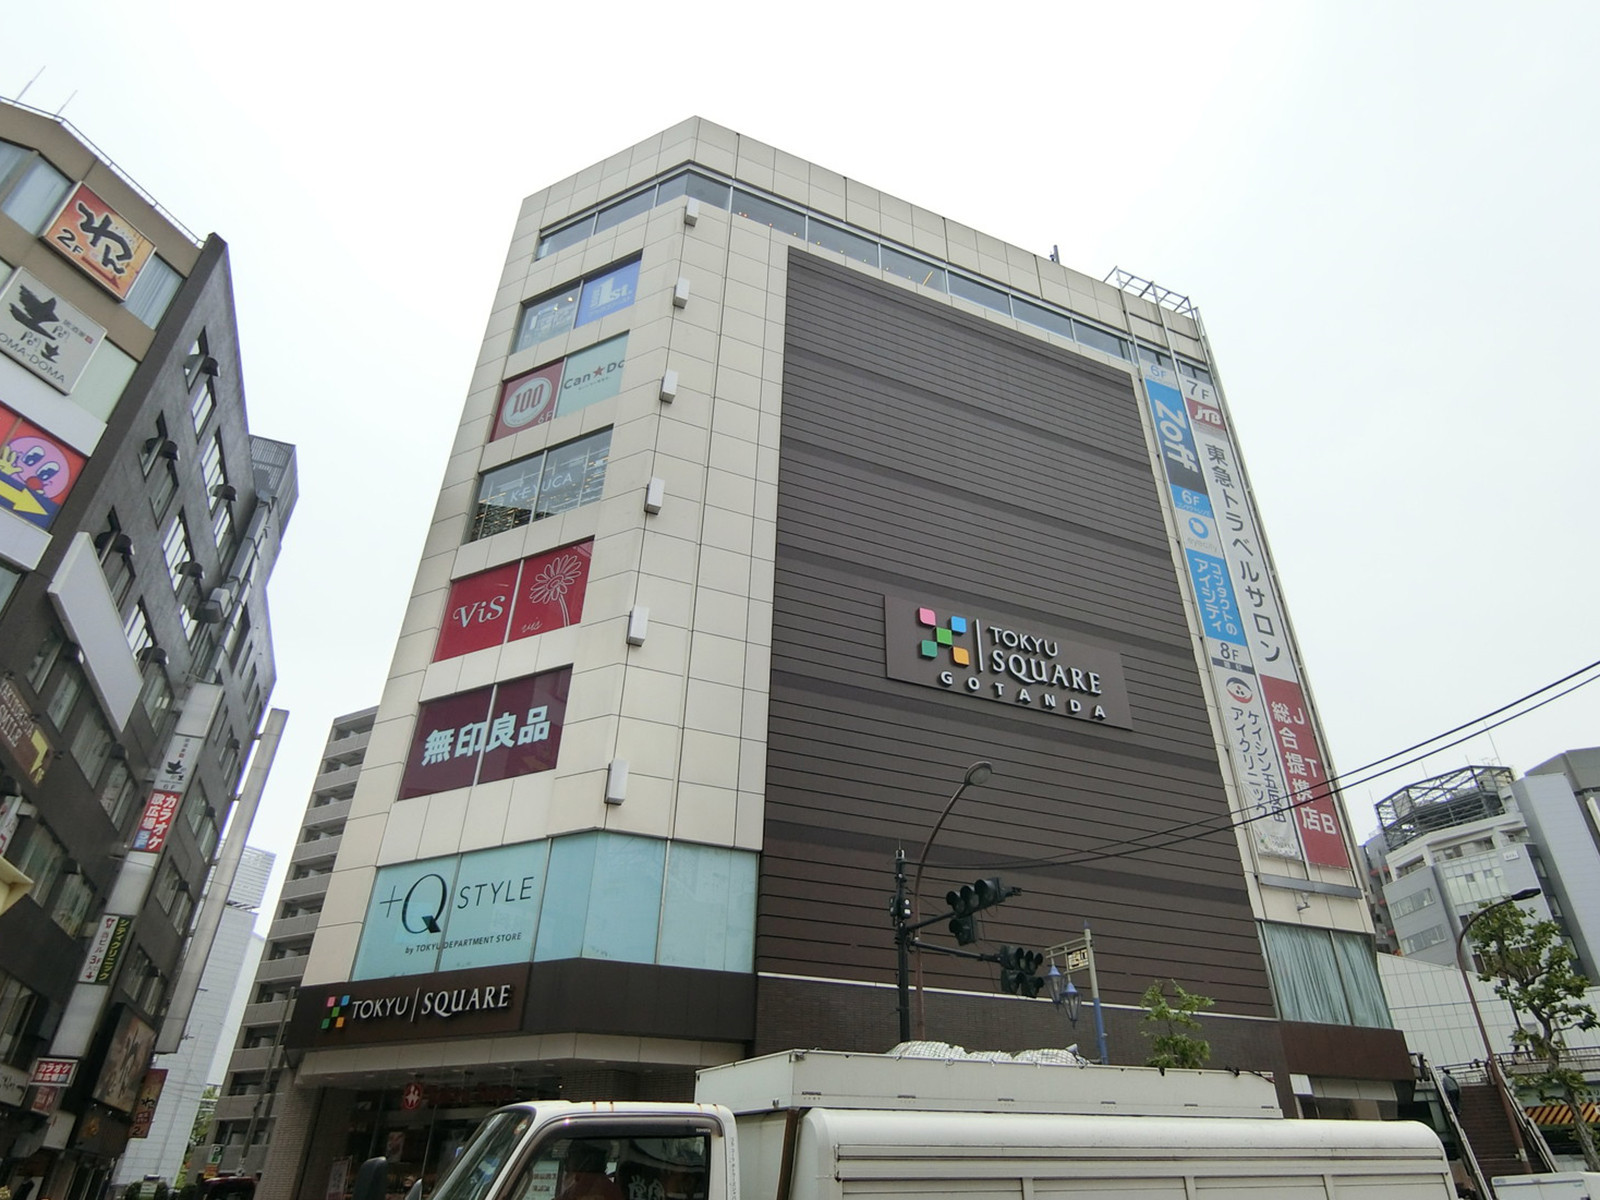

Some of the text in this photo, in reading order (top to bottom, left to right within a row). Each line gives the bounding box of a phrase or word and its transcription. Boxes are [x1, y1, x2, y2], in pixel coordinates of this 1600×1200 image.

[57, 229, 84, 255] 2F
[564, 373, 591, 390] Can
[1150, 364, 1167, 378] 6F
[511, 383, 544, 417] 100
[1186, 379, 1210, 399] 7F
[538, 412, 552, 424] 6F
[1195, 405, 1221, 425] JTB
[1154, 399, 1199, 473] Zoff
[510, 473, 574, 503] KEYUCA
[1182, 490, 1200, 506] 6F
[1205, 443, 1280, 663] 東急トラベルサロン
[453, 595, 506, 628] ViS
[1194, 558, 1222, 632] アイシティ
[1210, 561, 1238, 636] コンタクトの
[990, 626, 1058, 657] TOKYU
[1220, 642, 1239, 661] 8F
[992, 650, 1102, 694] SQUARE
[940, 671, 1107, 719] GOTANDA
[421, 705, 551, 767] 無印良品
[1231, 707, 1267, 816] アイクリニック
[1271, 701, 1322, 831] 総合提携店
[148, 795, 178, 850] カラオケ
[457, 876, 535, 909] STYLE
[405, 932, 522, 955] by TOKYU DEPARTMENT STORE
[352, 984, 511, 1020] TOKYU SQUARE
[38, 1062, 72, 1074] カラオケ
